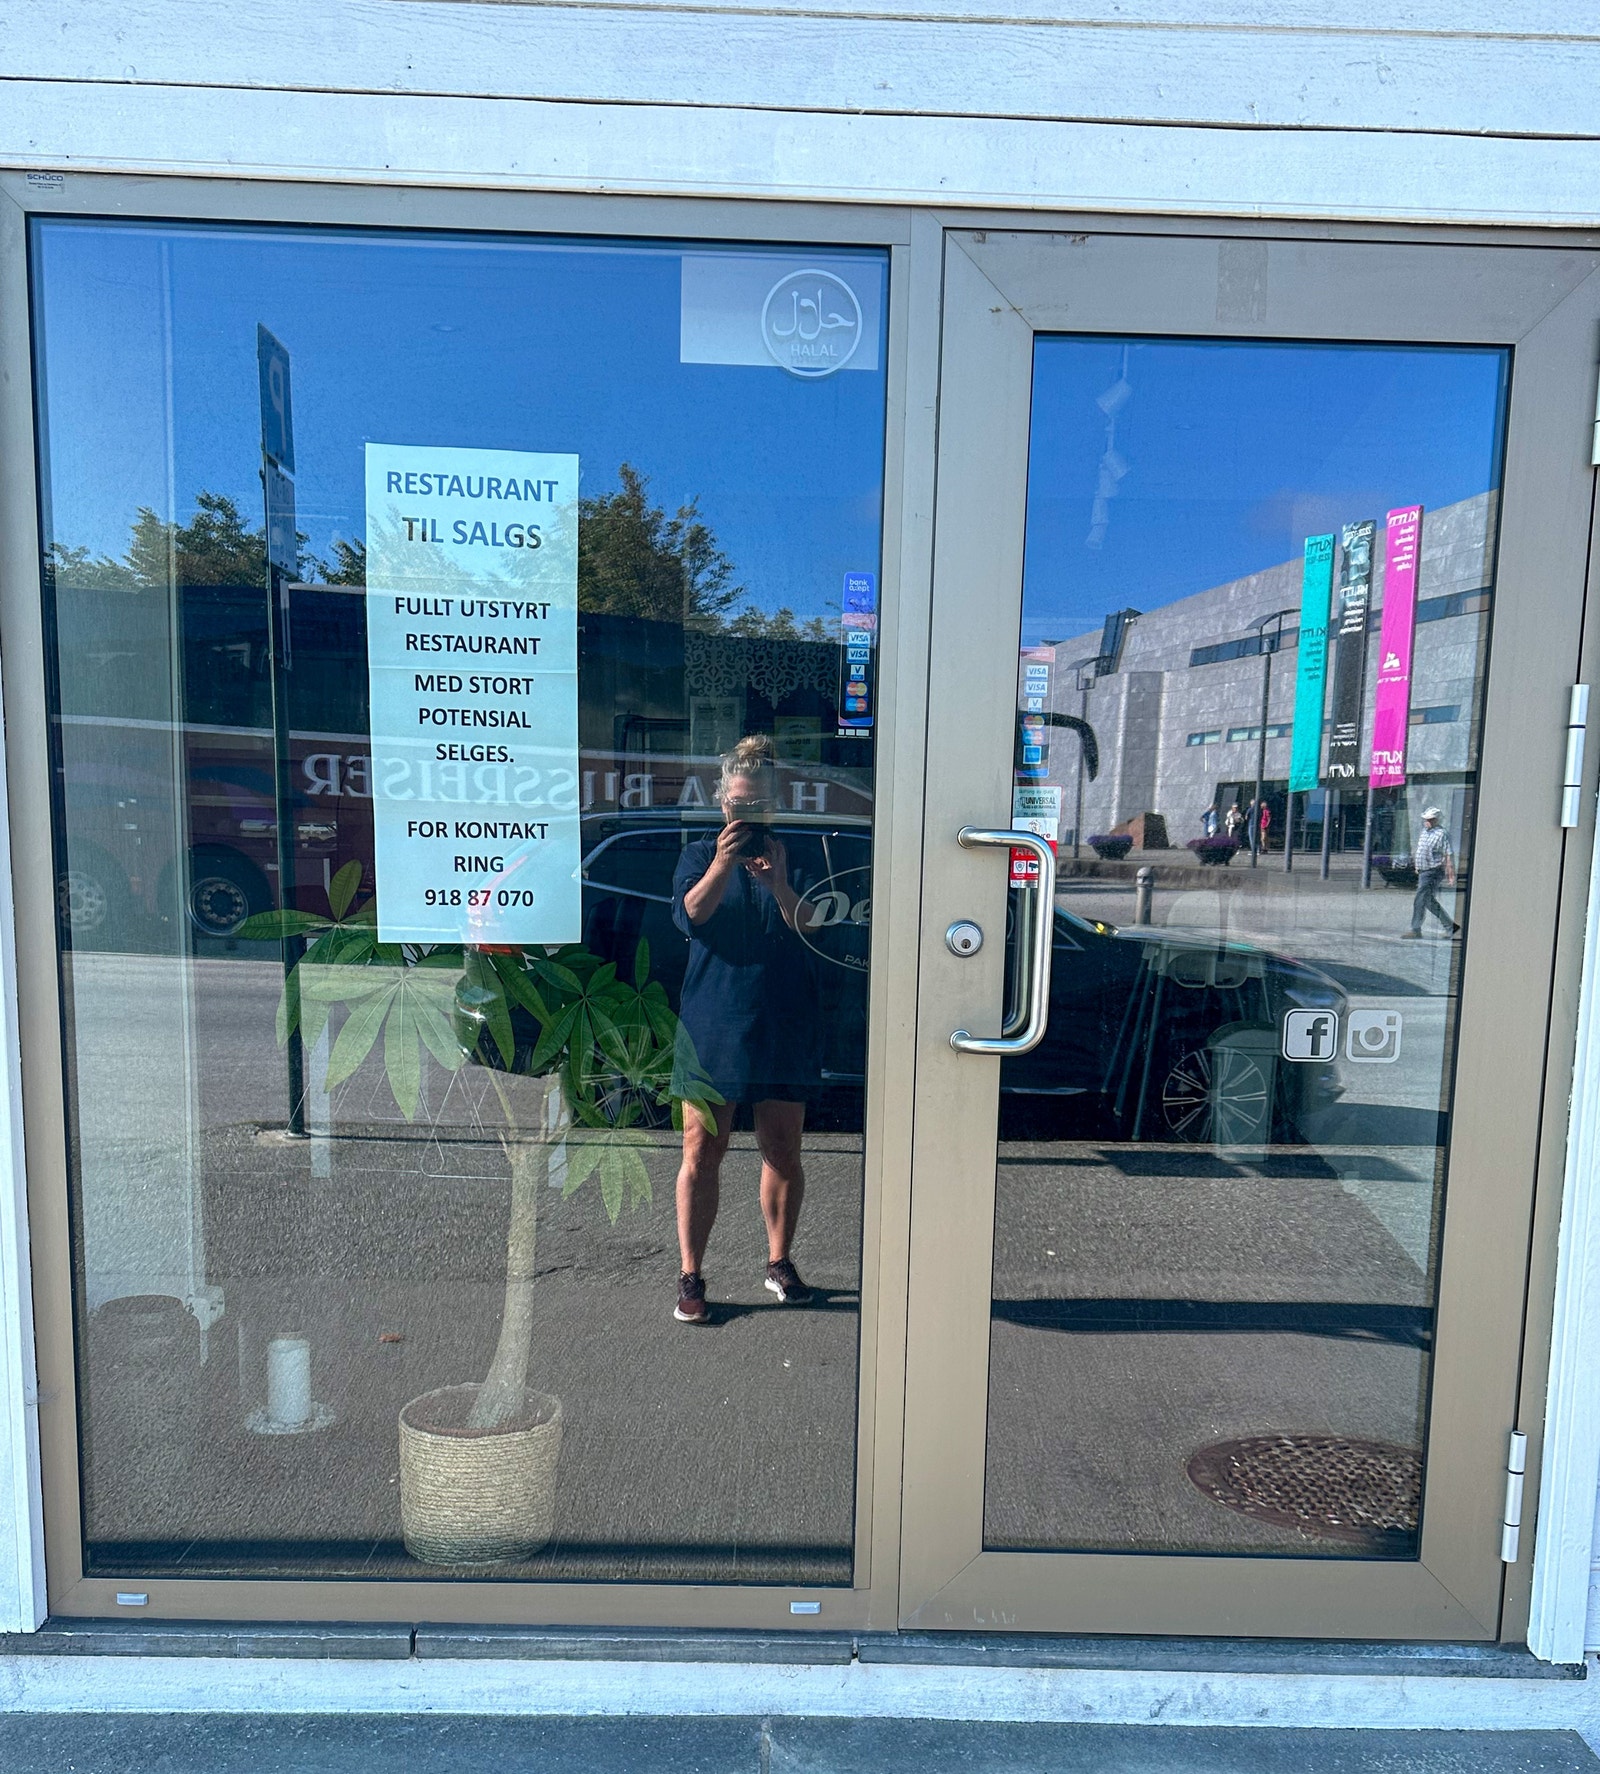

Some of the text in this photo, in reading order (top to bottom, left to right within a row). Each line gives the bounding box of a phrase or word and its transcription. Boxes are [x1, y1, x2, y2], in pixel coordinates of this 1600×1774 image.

[27, 173, 63, 181] SCHÜCO
[772, 288, 855, 340] حلال
[791, 344, 838, 357] HALAL
[387, 471, 558, 502] RESTAURANT
[402, 517, 542, 549] TIL SALGS
[849, 578, 868, 586] bank
[395, 596, 551, 620] FULLT UTSTYRT
[405, 633, 541, 655] RESTAURANT
[850, 634, 869, 642] VISA
[850, 650, 868, 658] VISA
[1028, 667, 1047, 675] VISA
[415, 674, 534, 695] MED STORT
[1027, 683, 1046, 691] VISA
[419, 707, 532, 729] POTENSIAL
[436, 743, 514, 763] SELGES.
[1026, 796, 1056, 805] UNIVERSAL
[407, 821, 549, 840] FOR KONTAKT
[454, 856, 504, 873] RING
[425, 889, 534, 907] 918 87 070
